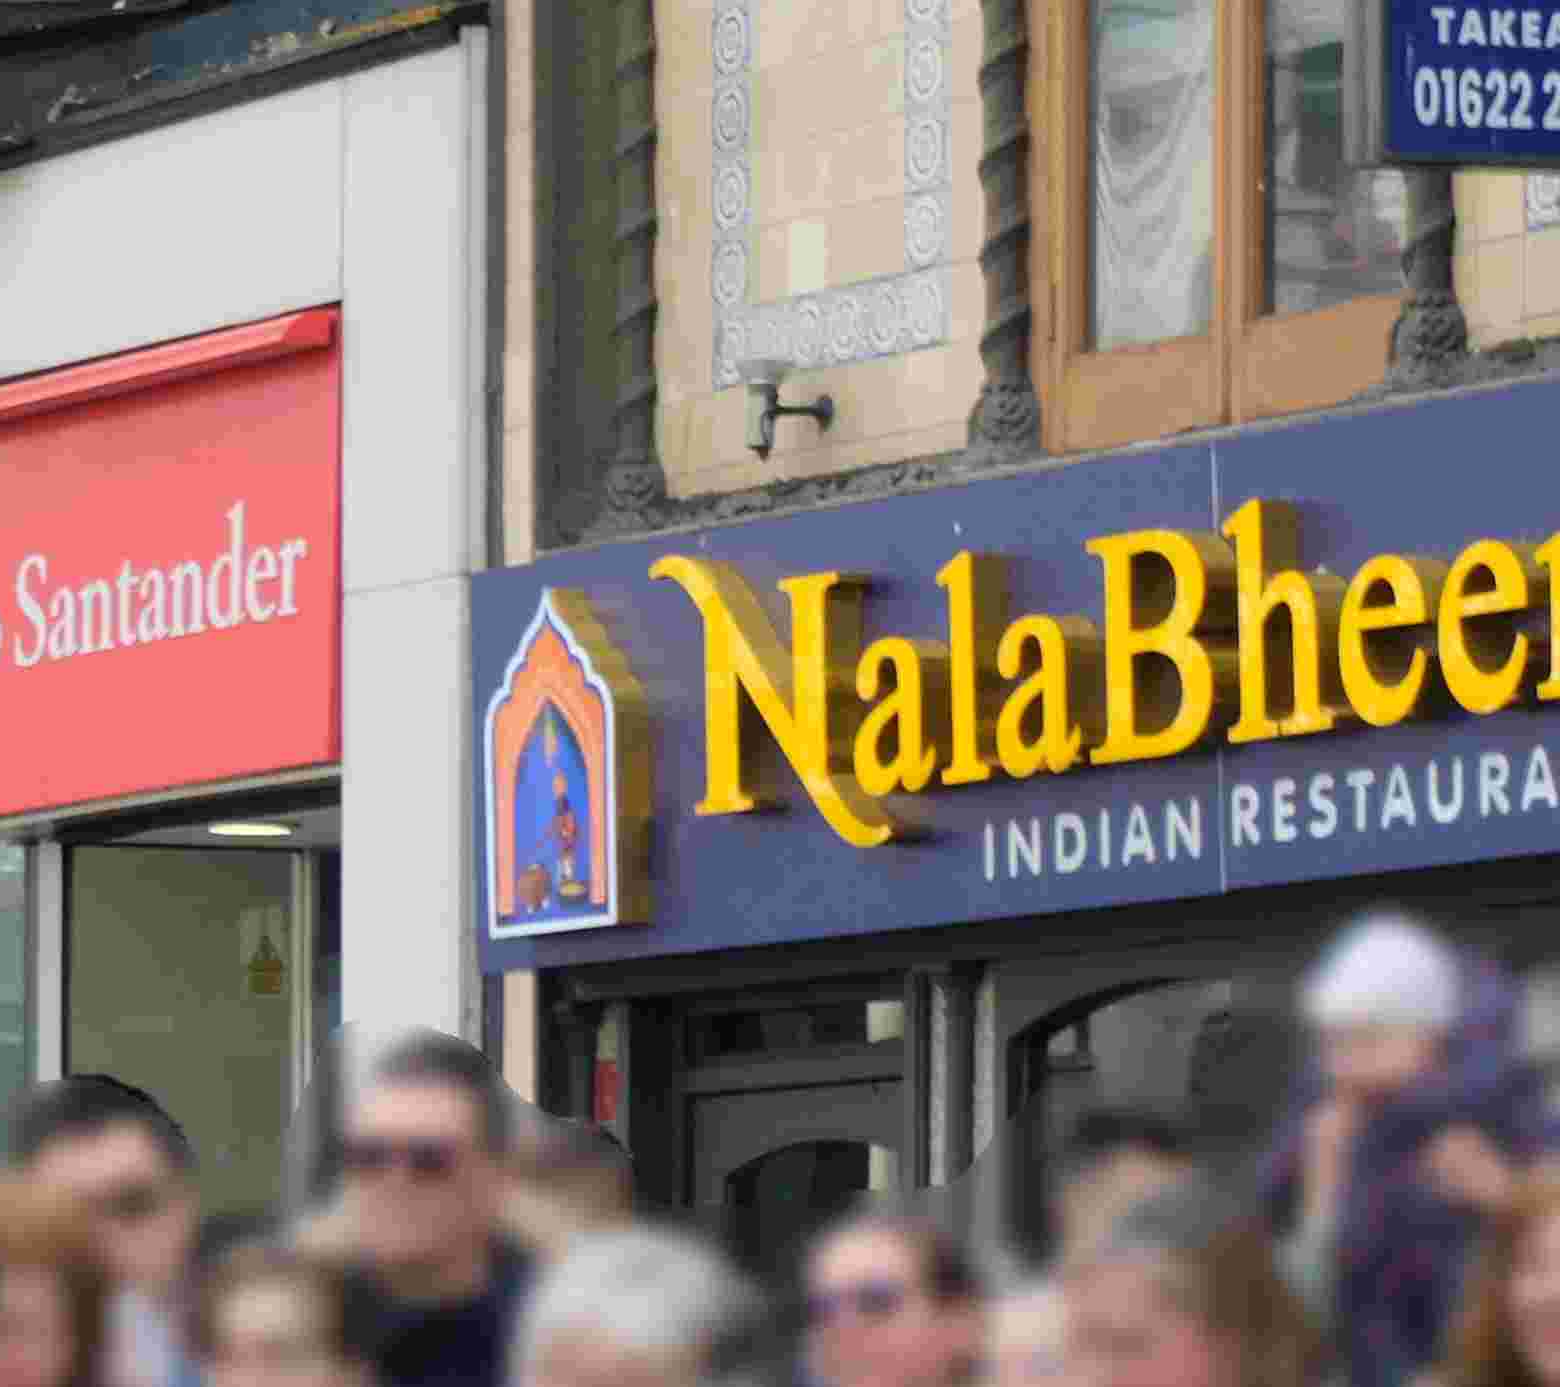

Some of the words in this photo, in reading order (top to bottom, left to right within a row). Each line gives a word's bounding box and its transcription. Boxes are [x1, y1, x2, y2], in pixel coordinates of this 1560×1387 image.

[1413, 66, 1534, 129] 01622
[13, 499, 307, 668] Santander
[983, 797, 1203, 882] INDIAN
[1230, 744, 1560, 849] RESTAURA
